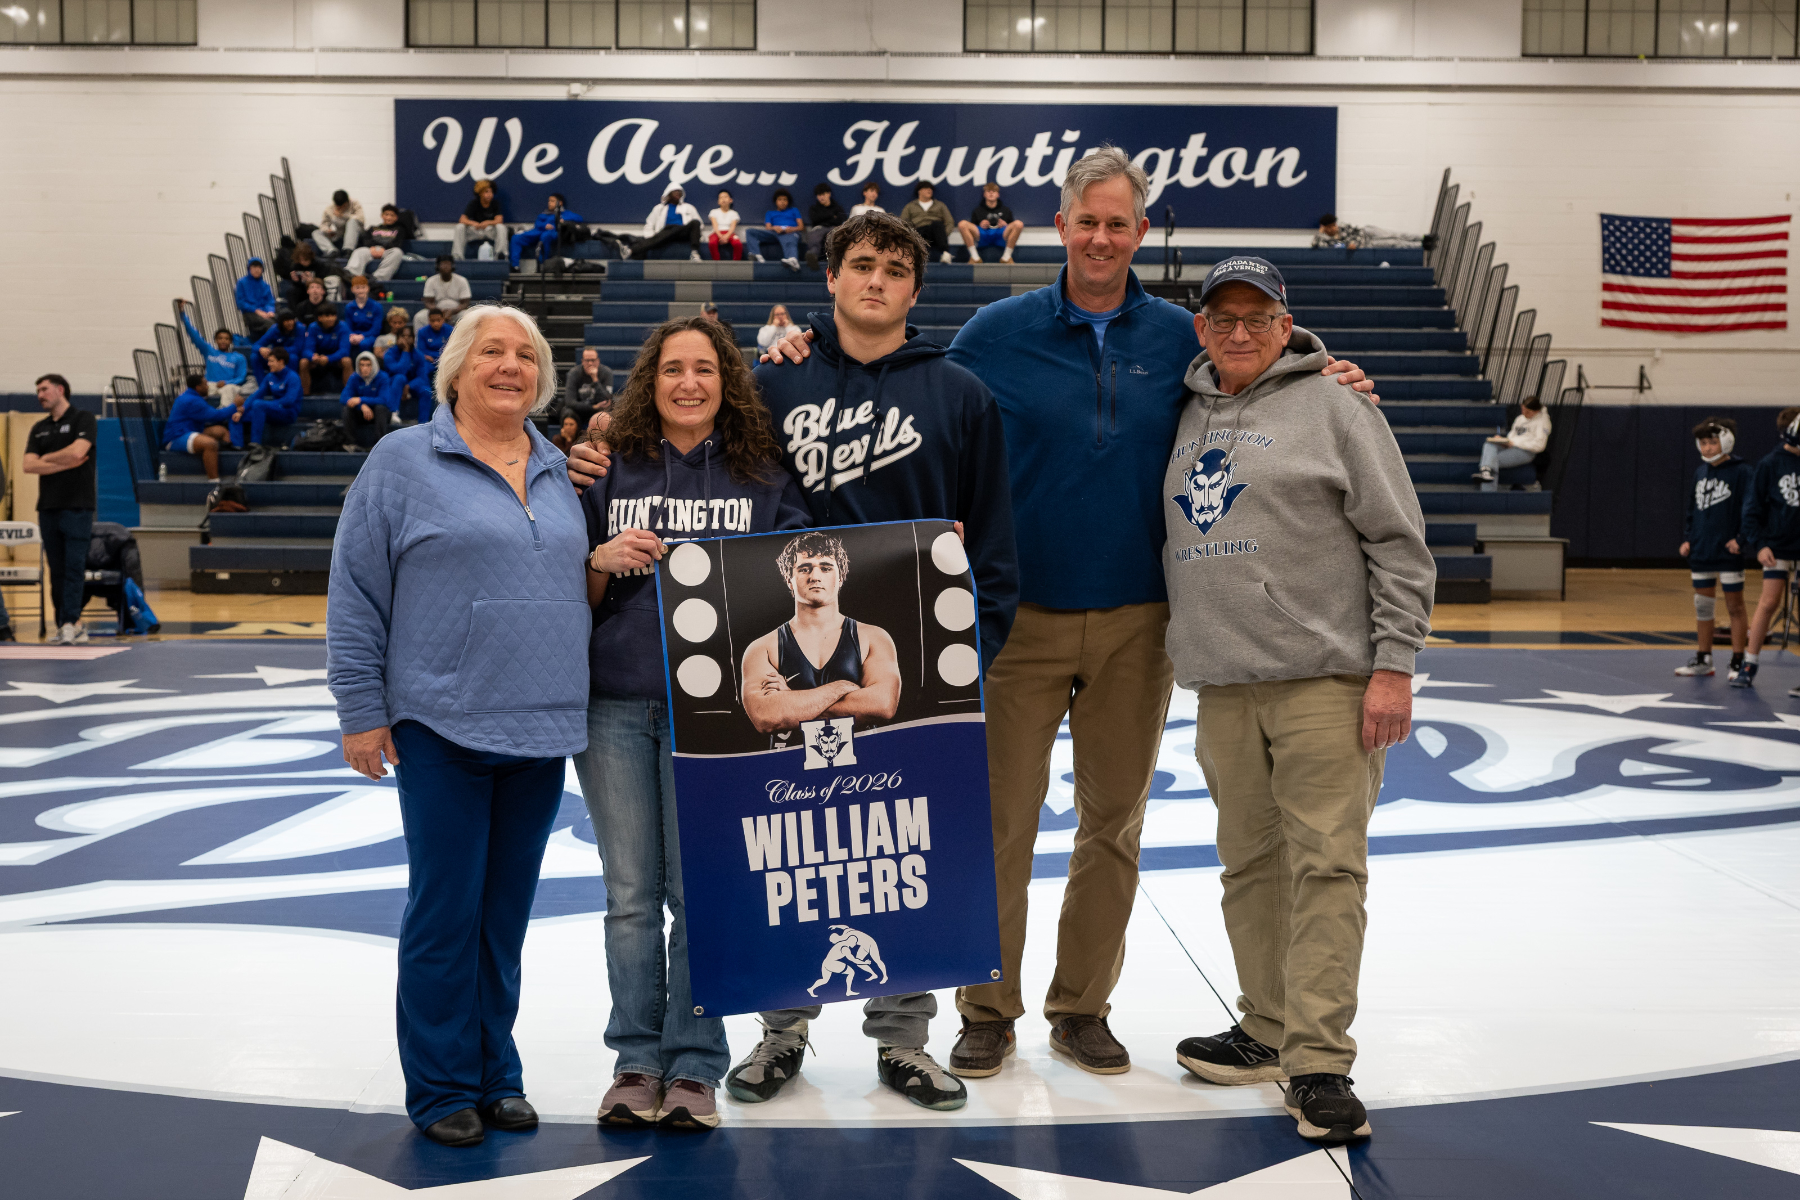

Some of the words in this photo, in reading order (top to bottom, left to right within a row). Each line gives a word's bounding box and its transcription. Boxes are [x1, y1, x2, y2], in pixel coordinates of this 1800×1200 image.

[422, 116, 564, 184] We
[586, 117, 798, 186] Are...
[826, 119, 1308, 209] Huntigton
[783, 397, 876, 453] Blue
[794, 406, 923, 493] Devils
[608, 495, 753, 537] HUNTINGTON
[1174, 538, 1260, 563] WRESTLING
[765, 778, 816, 804] Class
[819, 774, 843, 805] of
[840, 769, 903, 795] 2026
[741, 796, 931, 872] WILLIAM
[765, 854, 929, 927] PETERS
